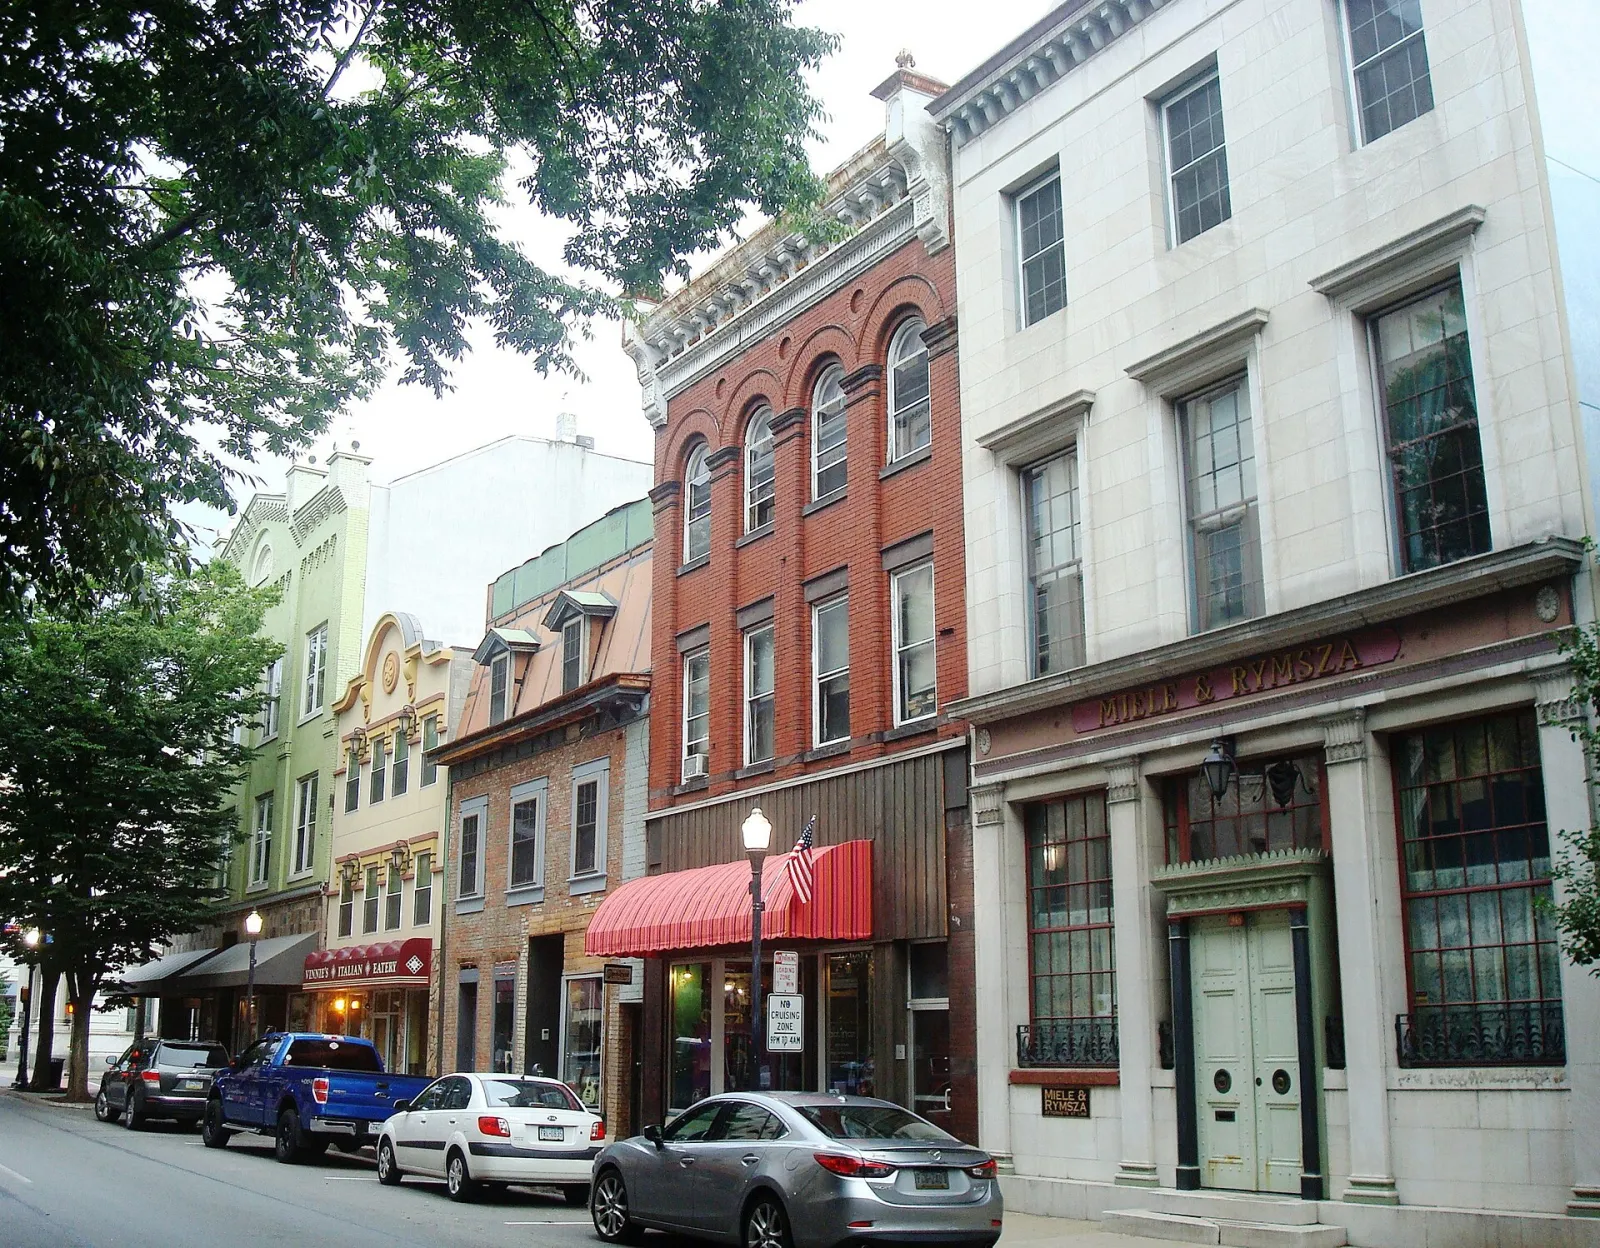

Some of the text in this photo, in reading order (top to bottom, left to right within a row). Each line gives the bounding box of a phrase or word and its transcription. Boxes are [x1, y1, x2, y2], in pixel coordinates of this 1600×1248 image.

[1100, 639, 1363, 725] MIELE & RYMSZA
[305, 960, 397, 979] VINNIE'S ITALIAN EATERY
[780, 1000, 791, 1008] NO
[771, 1011, 800, 1019] CRUISING
[777, 1022, 793, 1030] ZONE
[1044, 1089, 1086, 1100] MIELE &
[1045, 1100, 1086, 1111] RYMSZA
